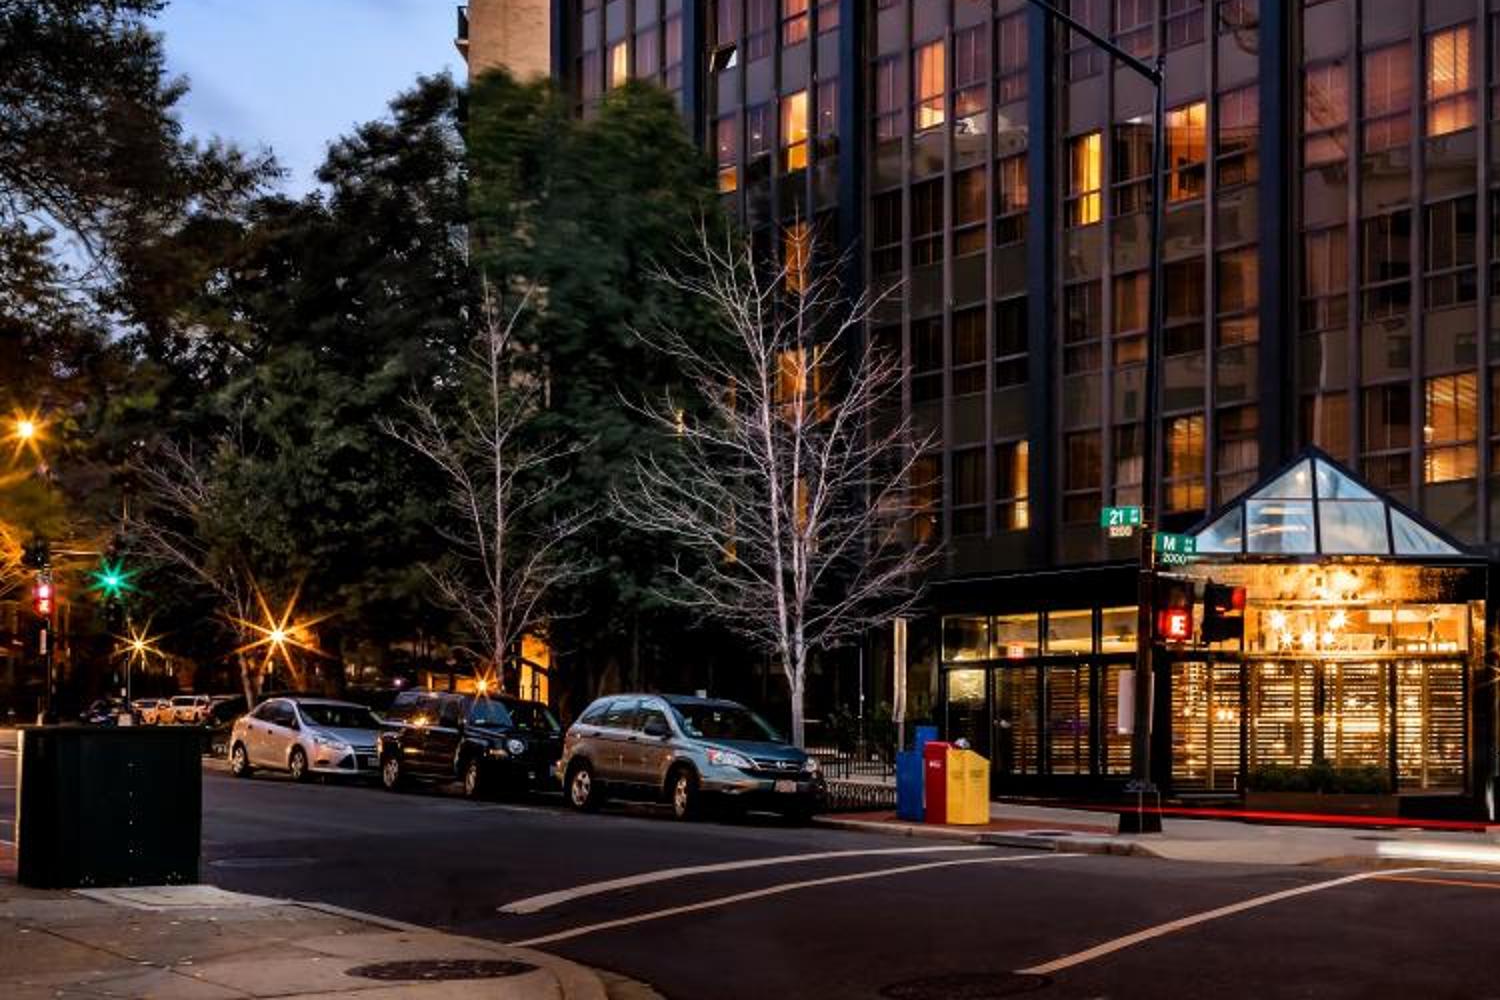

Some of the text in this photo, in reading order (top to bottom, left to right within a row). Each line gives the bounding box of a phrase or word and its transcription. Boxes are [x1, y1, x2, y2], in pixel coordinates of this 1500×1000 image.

[1109, 509, 1124, 525] 21
[1163, 535, 1176, 551] M
[1163, 552, 1186, 565] 2000
